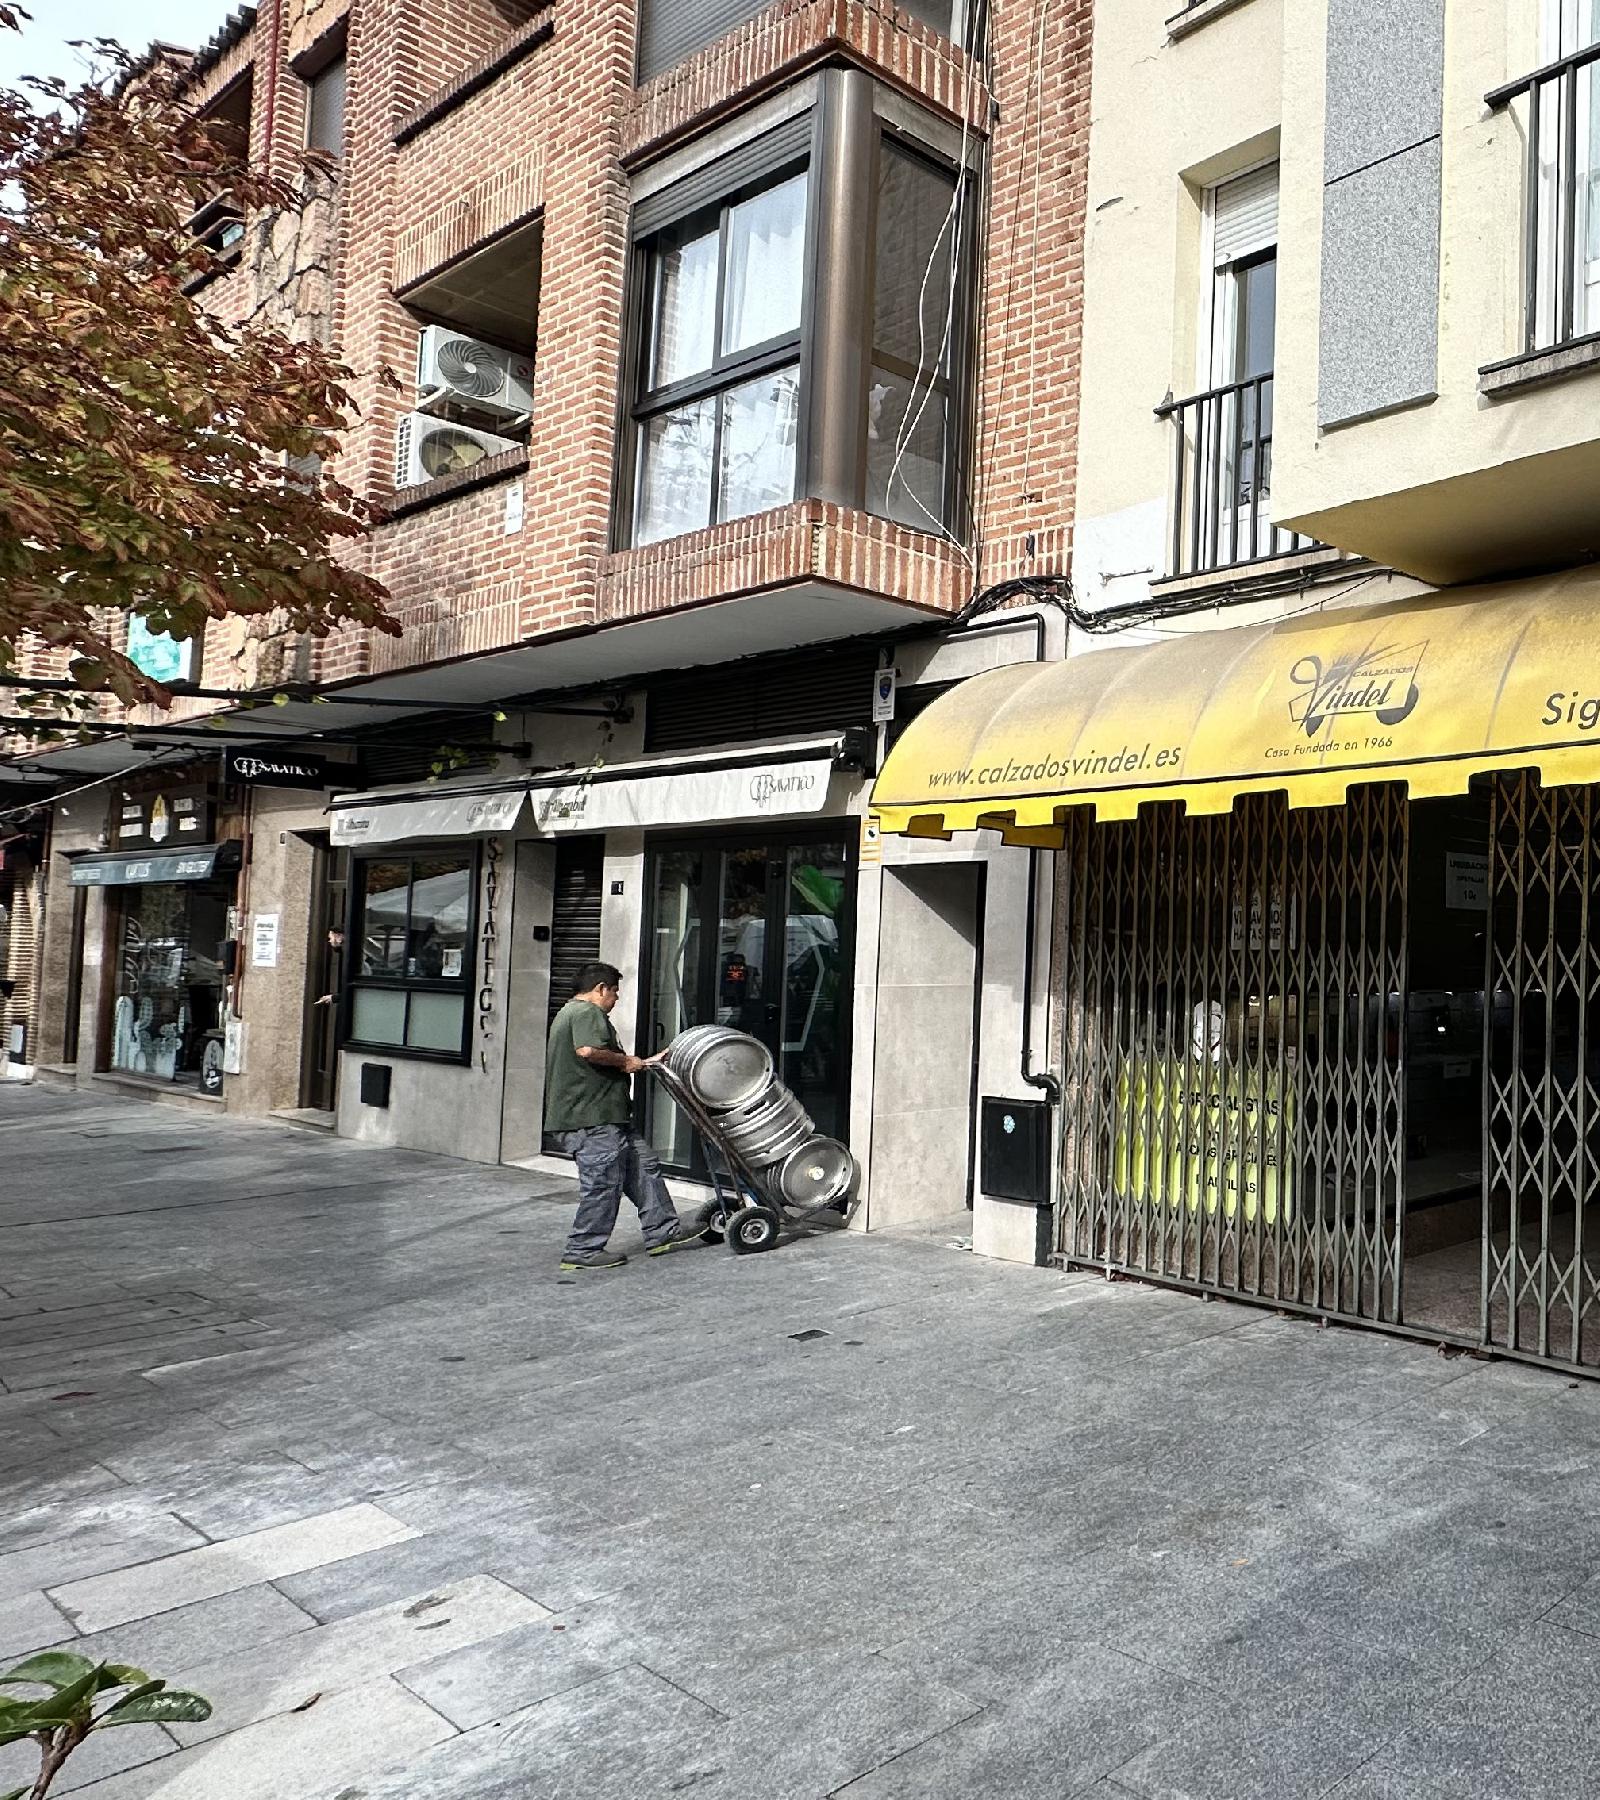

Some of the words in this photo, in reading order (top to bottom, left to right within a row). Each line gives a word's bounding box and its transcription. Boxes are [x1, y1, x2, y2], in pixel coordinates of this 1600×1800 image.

[1290, 645, 1398, 731] Vindel
[1353, 666, 1414, 678] CALZADOS
[1264, 746, 1290, 759] Casa
[1293, 739, 1341, 756] Fundada
[1344, 740, 1359, 751] en
[1364, 735, 1394, 749] 1966
[928, 743, 1182, 789] www.calzadosvindel.es
